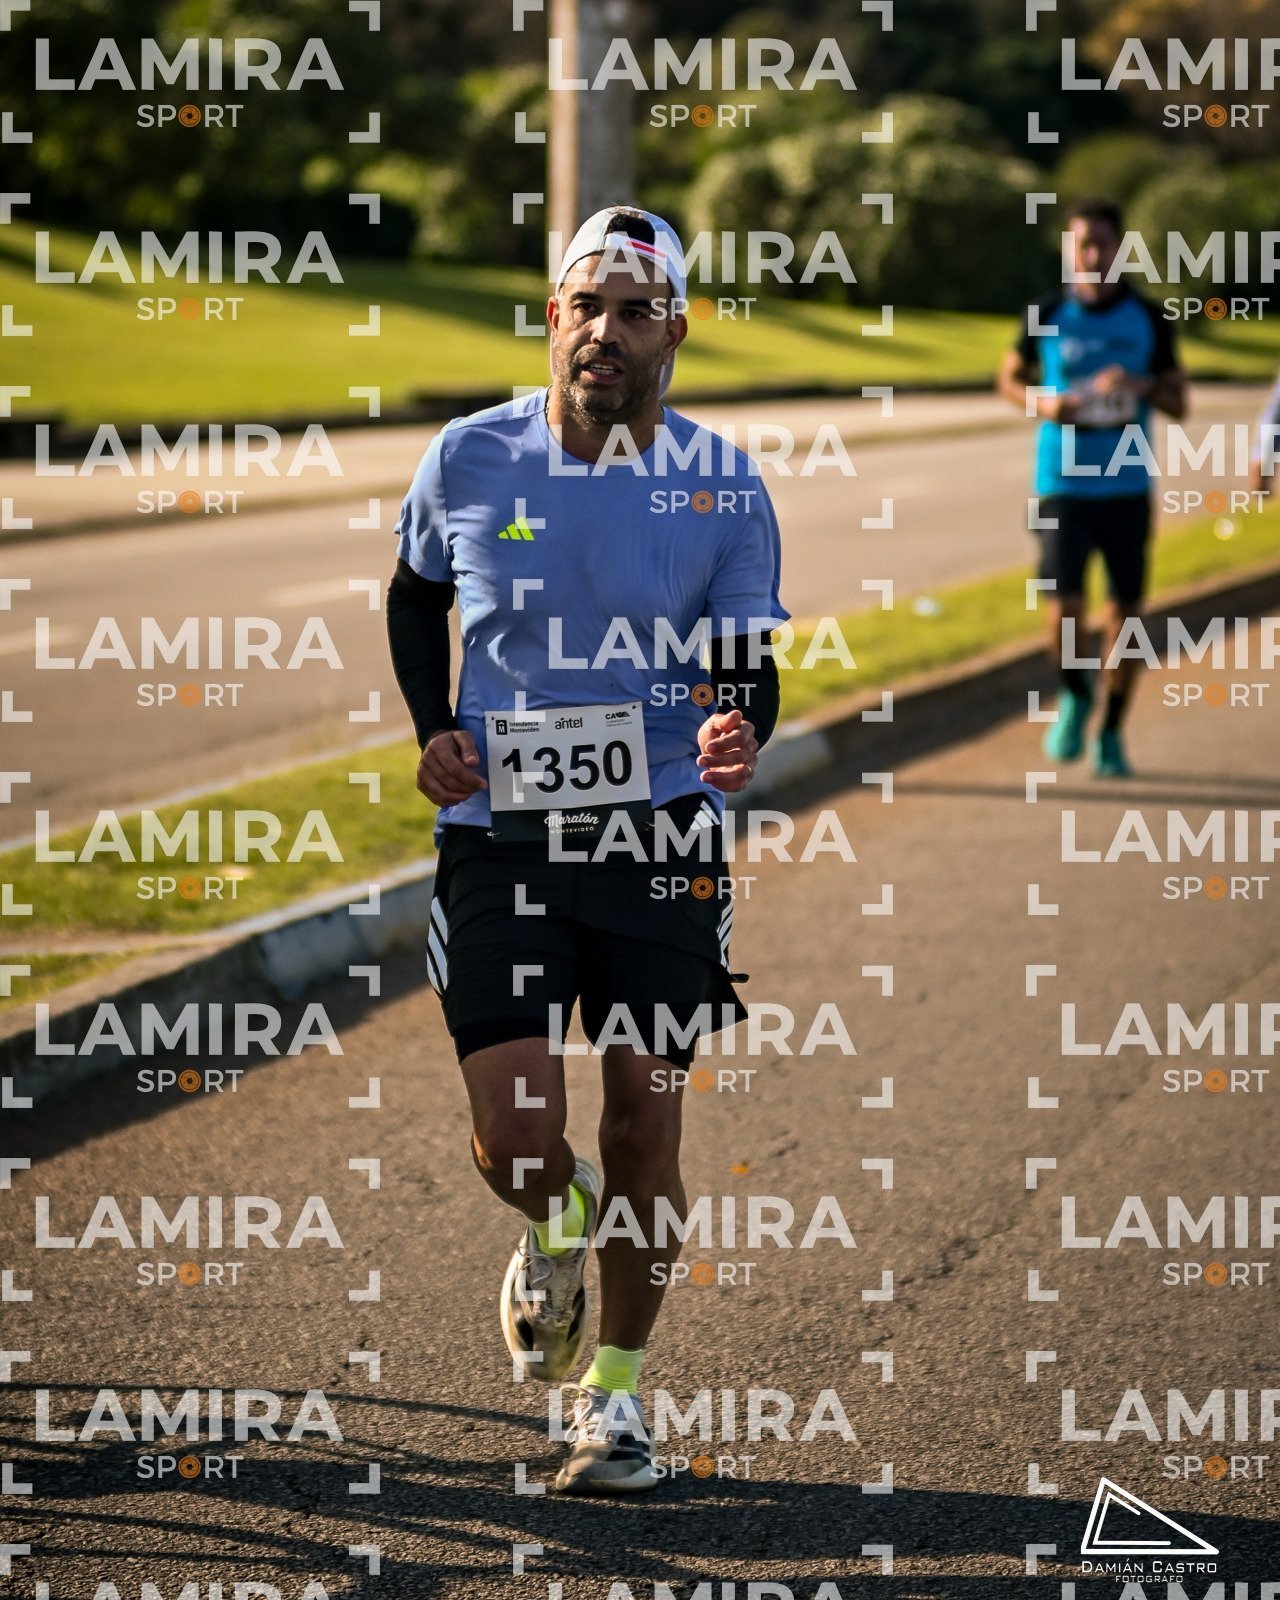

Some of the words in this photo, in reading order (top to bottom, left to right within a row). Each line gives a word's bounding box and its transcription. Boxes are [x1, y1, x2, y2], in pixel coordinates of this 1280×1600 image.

[555, 717, 583, 730] antel
[501, 740, 633, 794] 1350
[544, 812, 600, 828] Maratón
[550, 826, 595, 834] MONTEVIDEO
